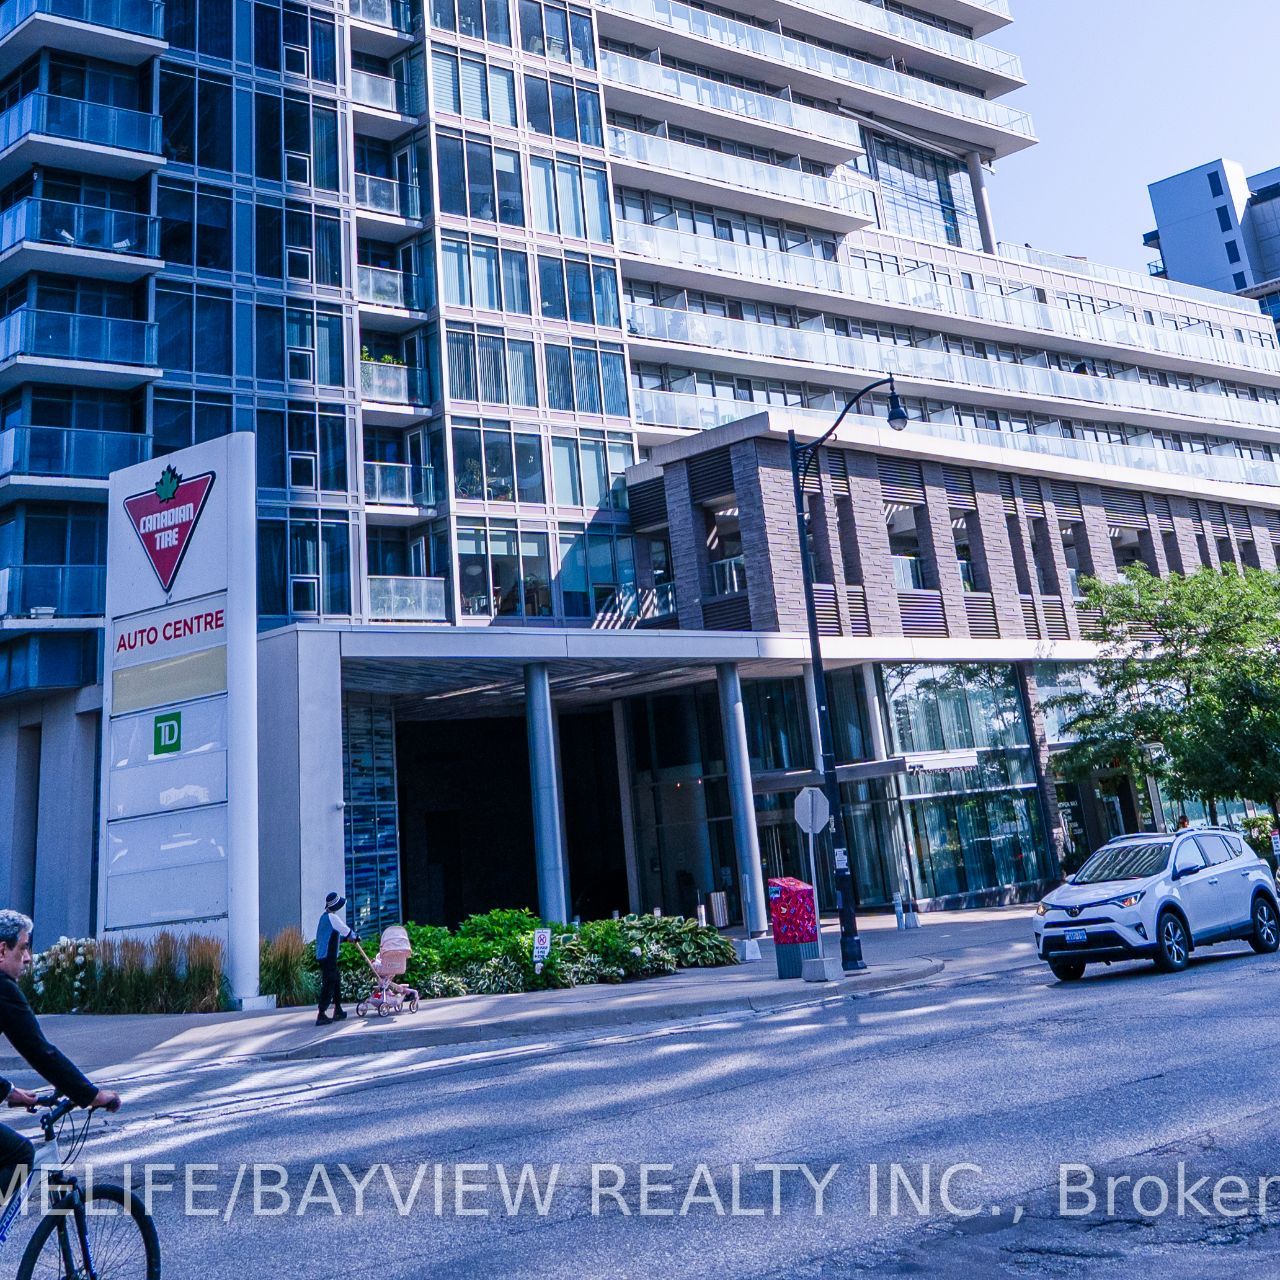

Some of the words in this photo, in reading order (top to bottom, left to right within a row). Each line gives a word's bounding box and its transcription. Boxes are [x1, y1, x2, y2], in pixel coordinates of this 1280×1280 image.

[139, 503, 194, 534] CANADIAN
[154, 529, 179, 550] TIRE
[116, 625, 159, 653] AUTO
[162, 609, 225, 641] CENTRE
[156, 720, 179, 746] TD
